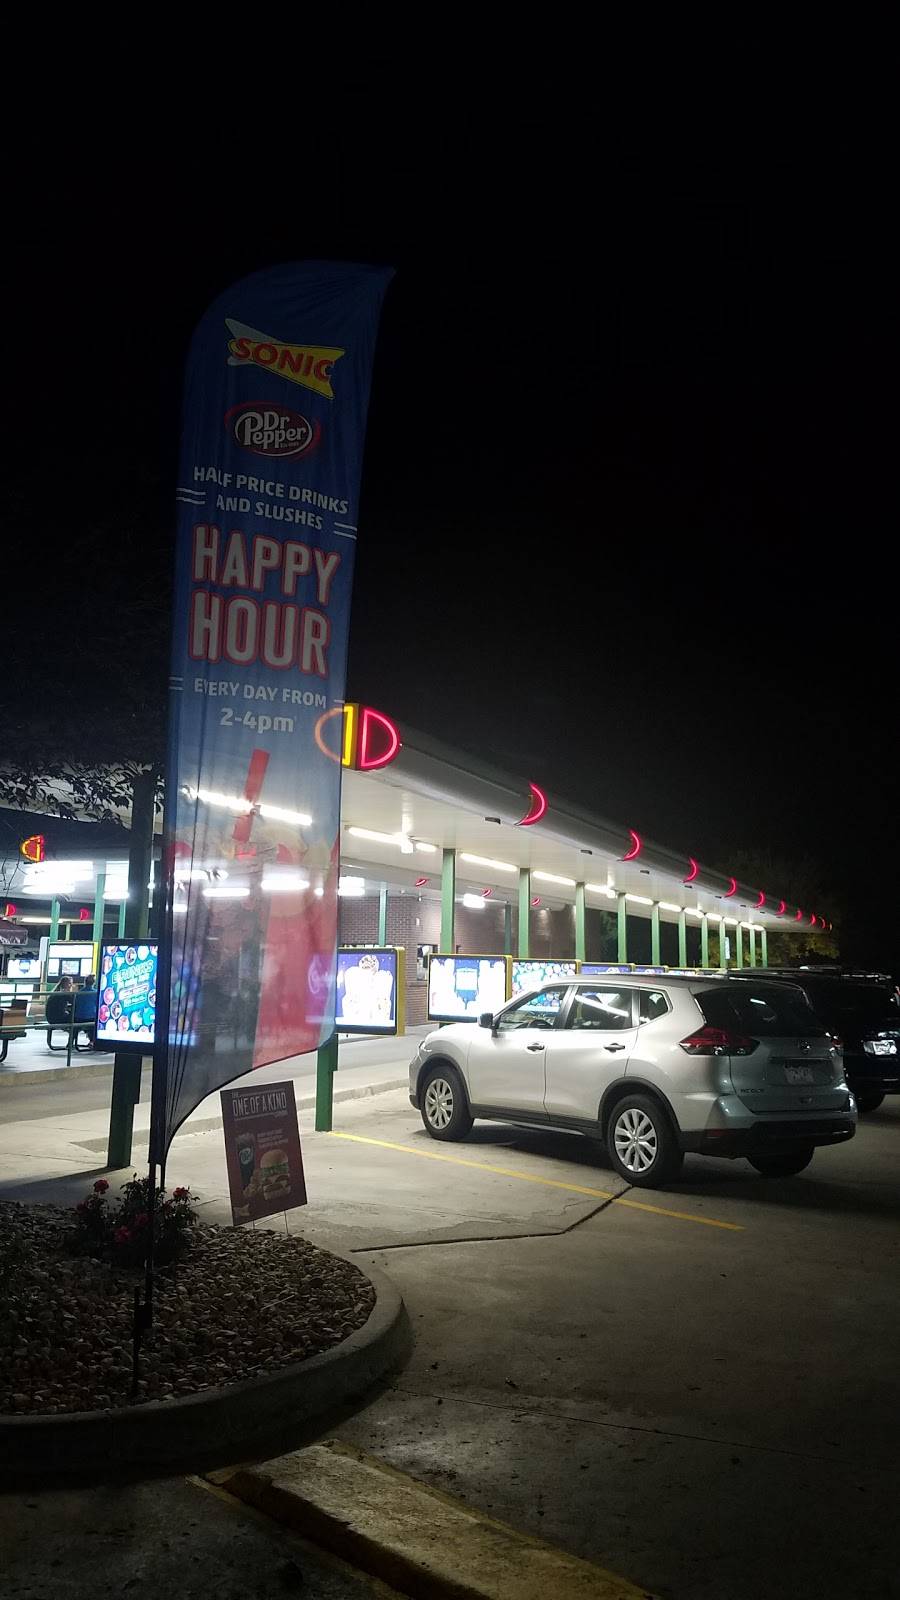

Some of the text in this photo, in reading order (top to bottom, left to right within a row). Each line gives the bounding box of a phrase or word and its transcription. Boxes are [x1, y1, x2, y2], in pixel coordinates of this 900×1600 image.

[234, 337, 336, 382] SONIC
[237, 412, 307, 449] Pepper
[264, 411, 290, 430] Dr
[193, 466, 349, 514] HALF PRICE DRINKS
[216, 494, 323, 530] AND SLUSHES
[191, 524, 340, 606] HAPPY
[188, 589, 330, 679] HOUR
[194, 678, 326, 708] EVERY DAY FROM
[220, 708, 294, 734] 2-4pm
[232, 1092, 287, 1117] ONE OF A KIND
